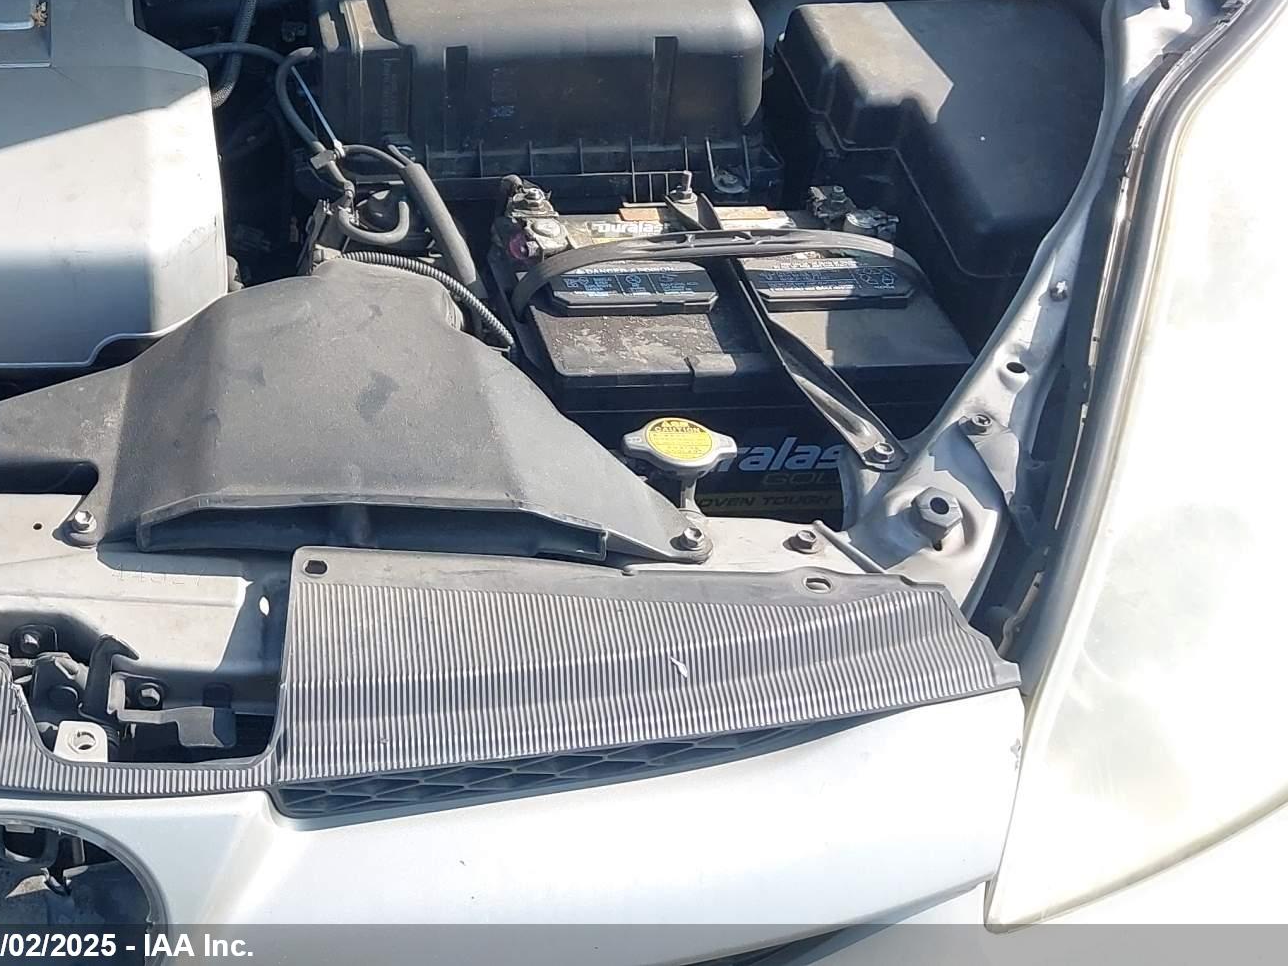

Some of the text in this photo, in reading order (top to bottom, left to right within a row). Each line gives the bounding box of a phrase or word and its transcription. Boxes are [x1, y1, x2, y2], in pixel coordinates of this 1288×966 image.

[654, 426, 702, 434] CAUTION
[710, 437, 845, 472] ralas
[762, 472, 839, 485] GOL
